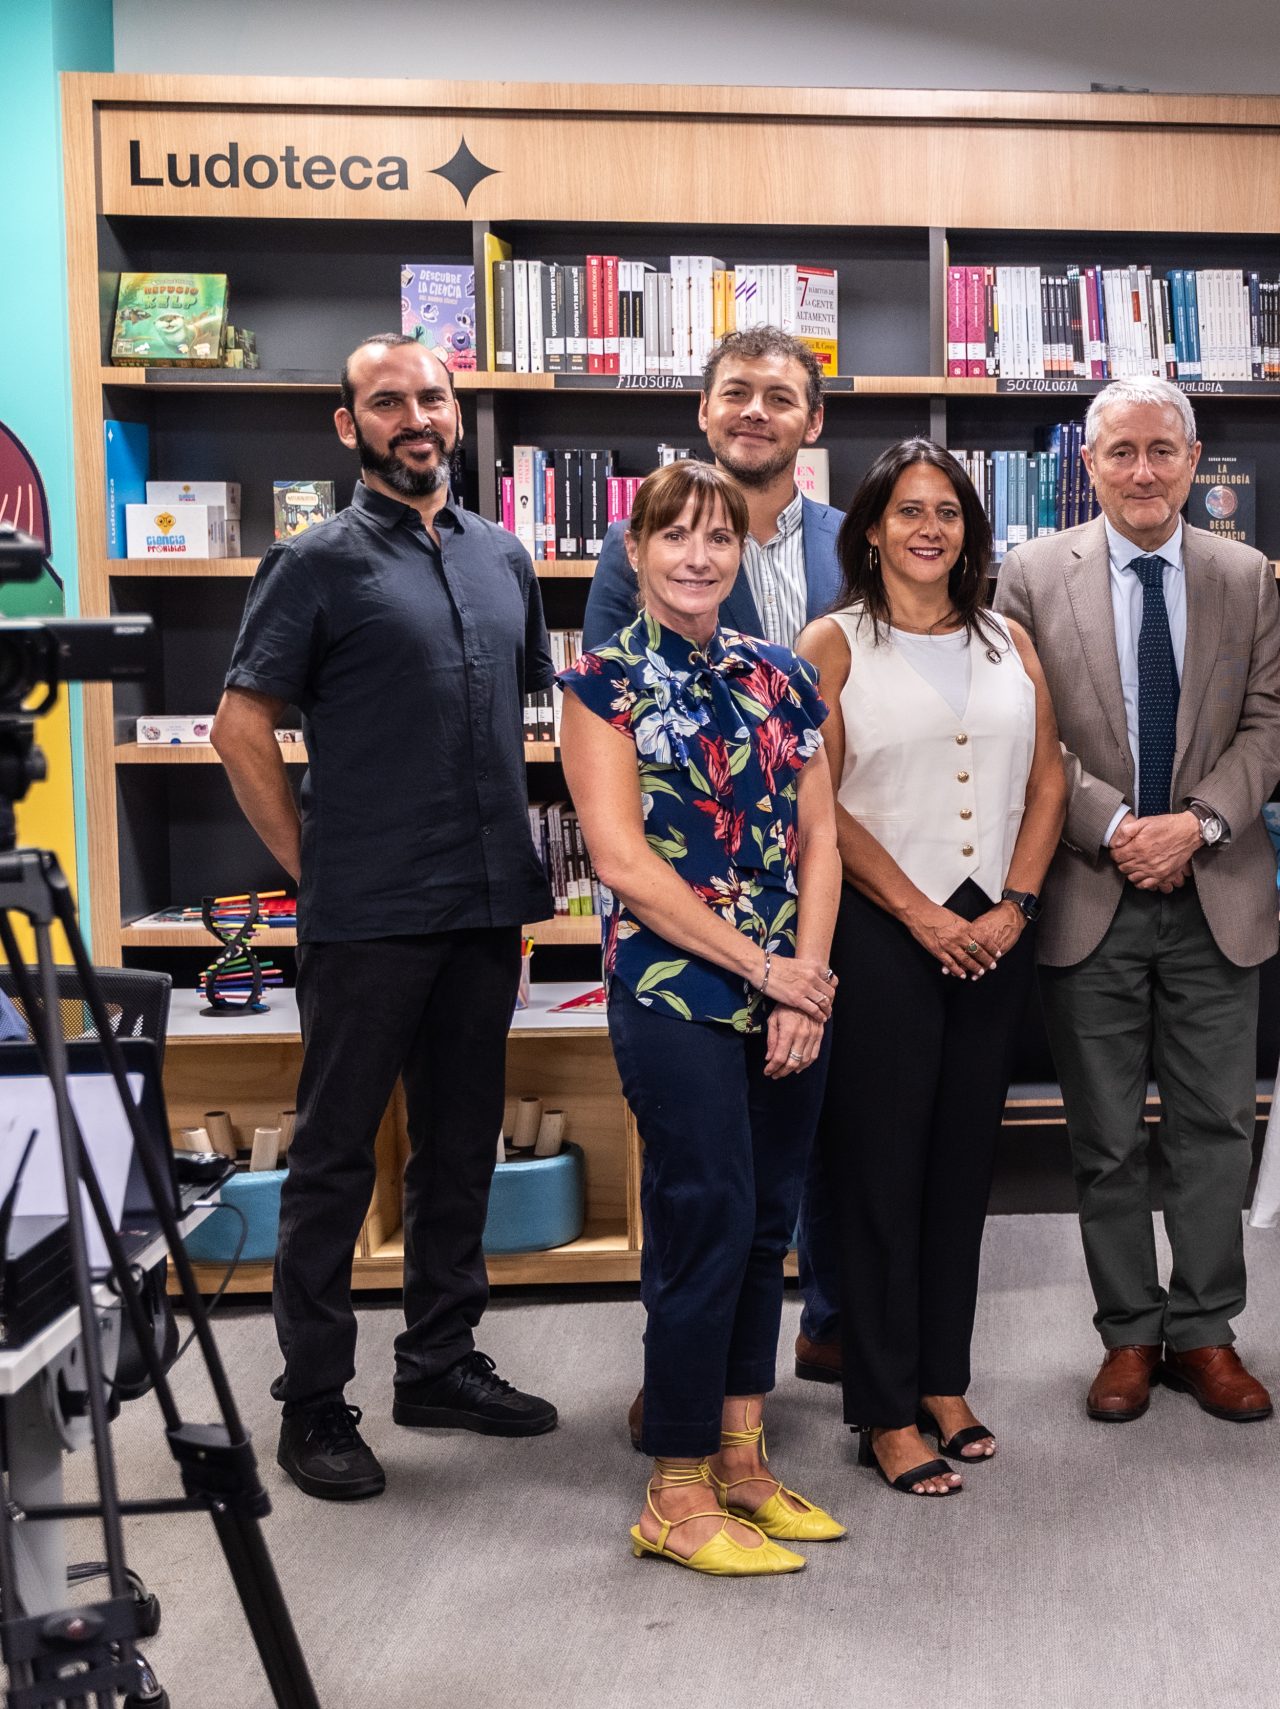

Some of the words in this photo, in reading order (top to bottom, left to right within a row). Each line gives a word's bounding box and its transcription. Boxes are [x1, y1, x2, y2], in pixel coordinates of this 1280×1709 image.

[129, 139, 409, 191] Ludoteca
[420, 270, 462, 284] DESCUBRE
[418, 281, 428, 293] LA
[429, 282, 462, 299] CIENCIA
[797, 276, 810, 308] 7
[812, 299, 834, 310] GENTE
[795, 310, 836, 324] ALTAMENTE
[800, 324, 832, 336] EFECTIVA
[1218, 464, 1228, 474] LA
[1195, 473, 1250, 485] ARQUEOLOGÍA
[1209, 520, 1236, 530] DESDE
